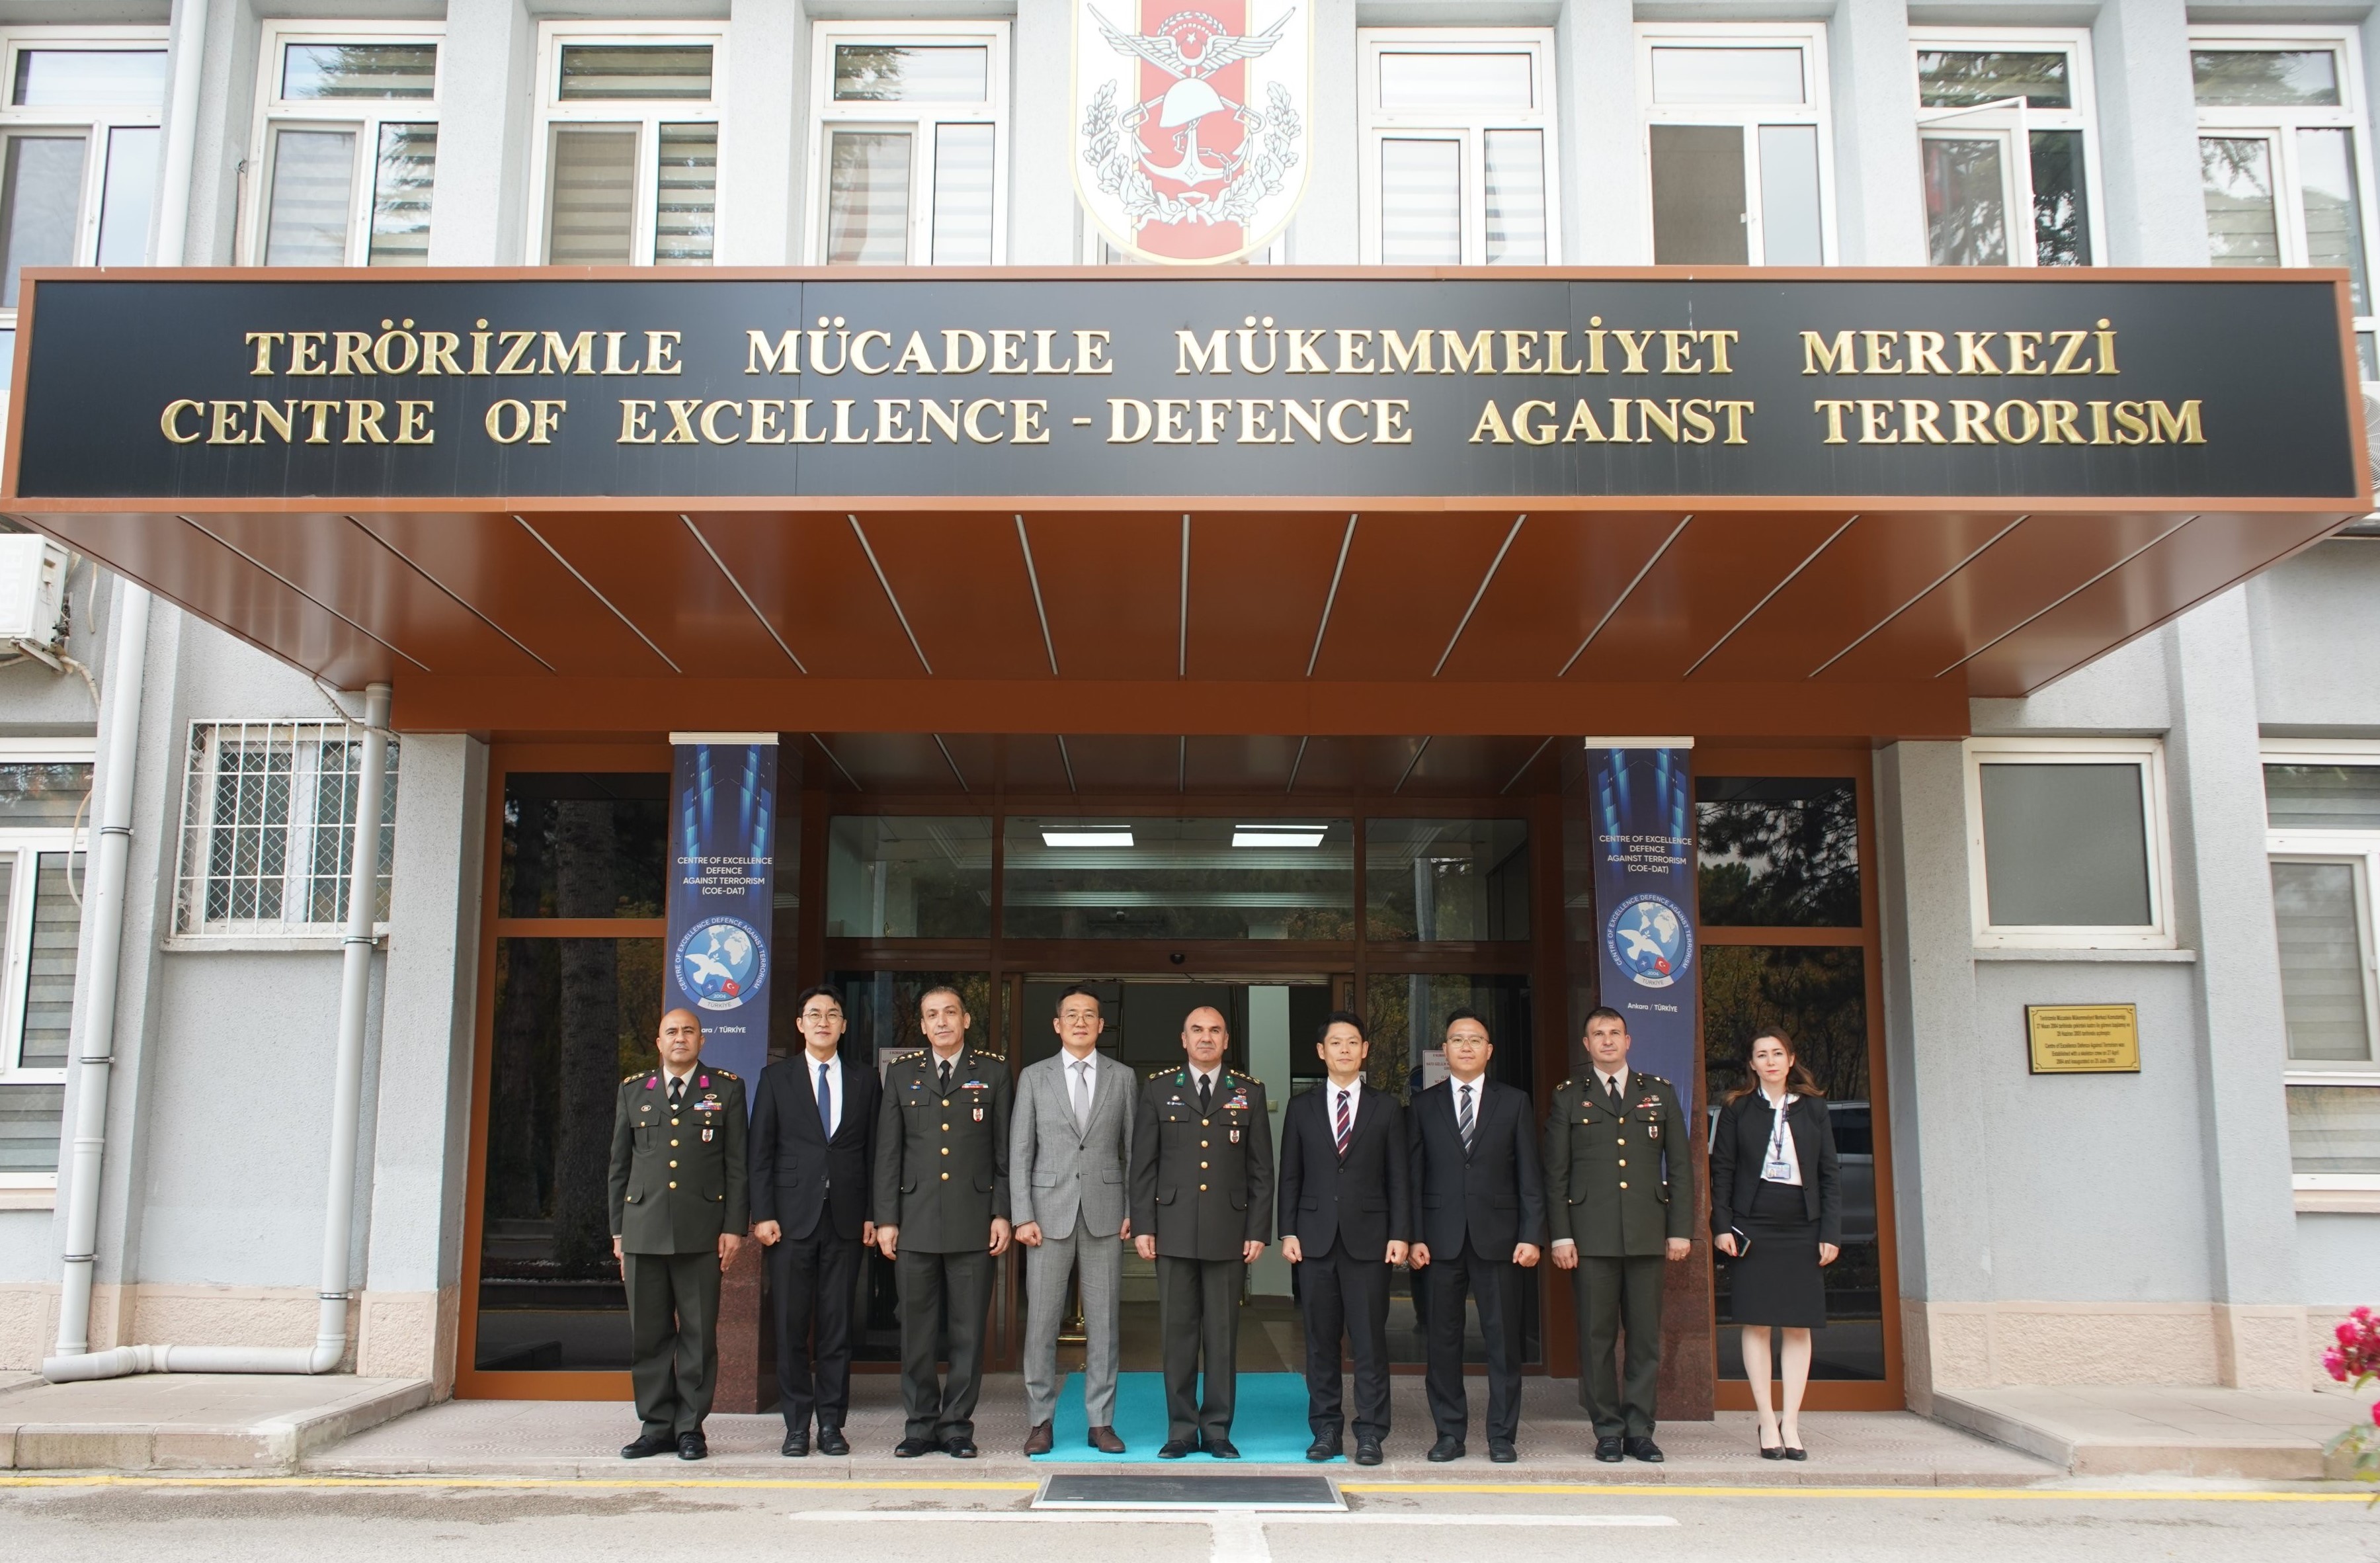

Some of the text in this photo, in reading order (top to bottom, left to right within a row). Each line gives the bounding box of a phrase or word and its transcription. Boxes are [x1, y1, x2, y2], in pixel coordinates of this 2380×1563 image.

[245, 315, 2120, 376] TERÖRİZMLE MÜCADELE MÜKEMMELİYET MERKEZİ
[160, 399, 435, 444] CENTRE
[485, 399, 567, 444] OF
[616, 398, 1050, 444] EXCELLENCE
[1106, 398, 1413, 444] DEFENCE
[1469, 398, 1755, 444] AGAINST
[1813, 398, 2207, 444] TERRORISM
[1645, 836, 1692, 845] EXCELLENCE
[1628, 865, 1669, 874] (COE-DAT)
[1644, 855, 1687, 865] TERRORISM
[1609, 896, 1639, 928] EXCELLENCE
[1640, 894, 1670, 906] DEFENCE
[712, 917, 743, 927] DEFENCE
[1669, 904, 1688, 929] AGAINST
[678, 919, 710, 952] EXCELLENCE
[743, 925, 763, 949] AGAINST
[1609, 941, 1622, 966] CENTRE
[1681, 930, 1692, 969] TERRORISM
[675, 964, 687, 990] CENTRE
[753, 949, 766, 989] TERRORISM
[1655, 1003, 1678, 1013] TÜRKİYE
